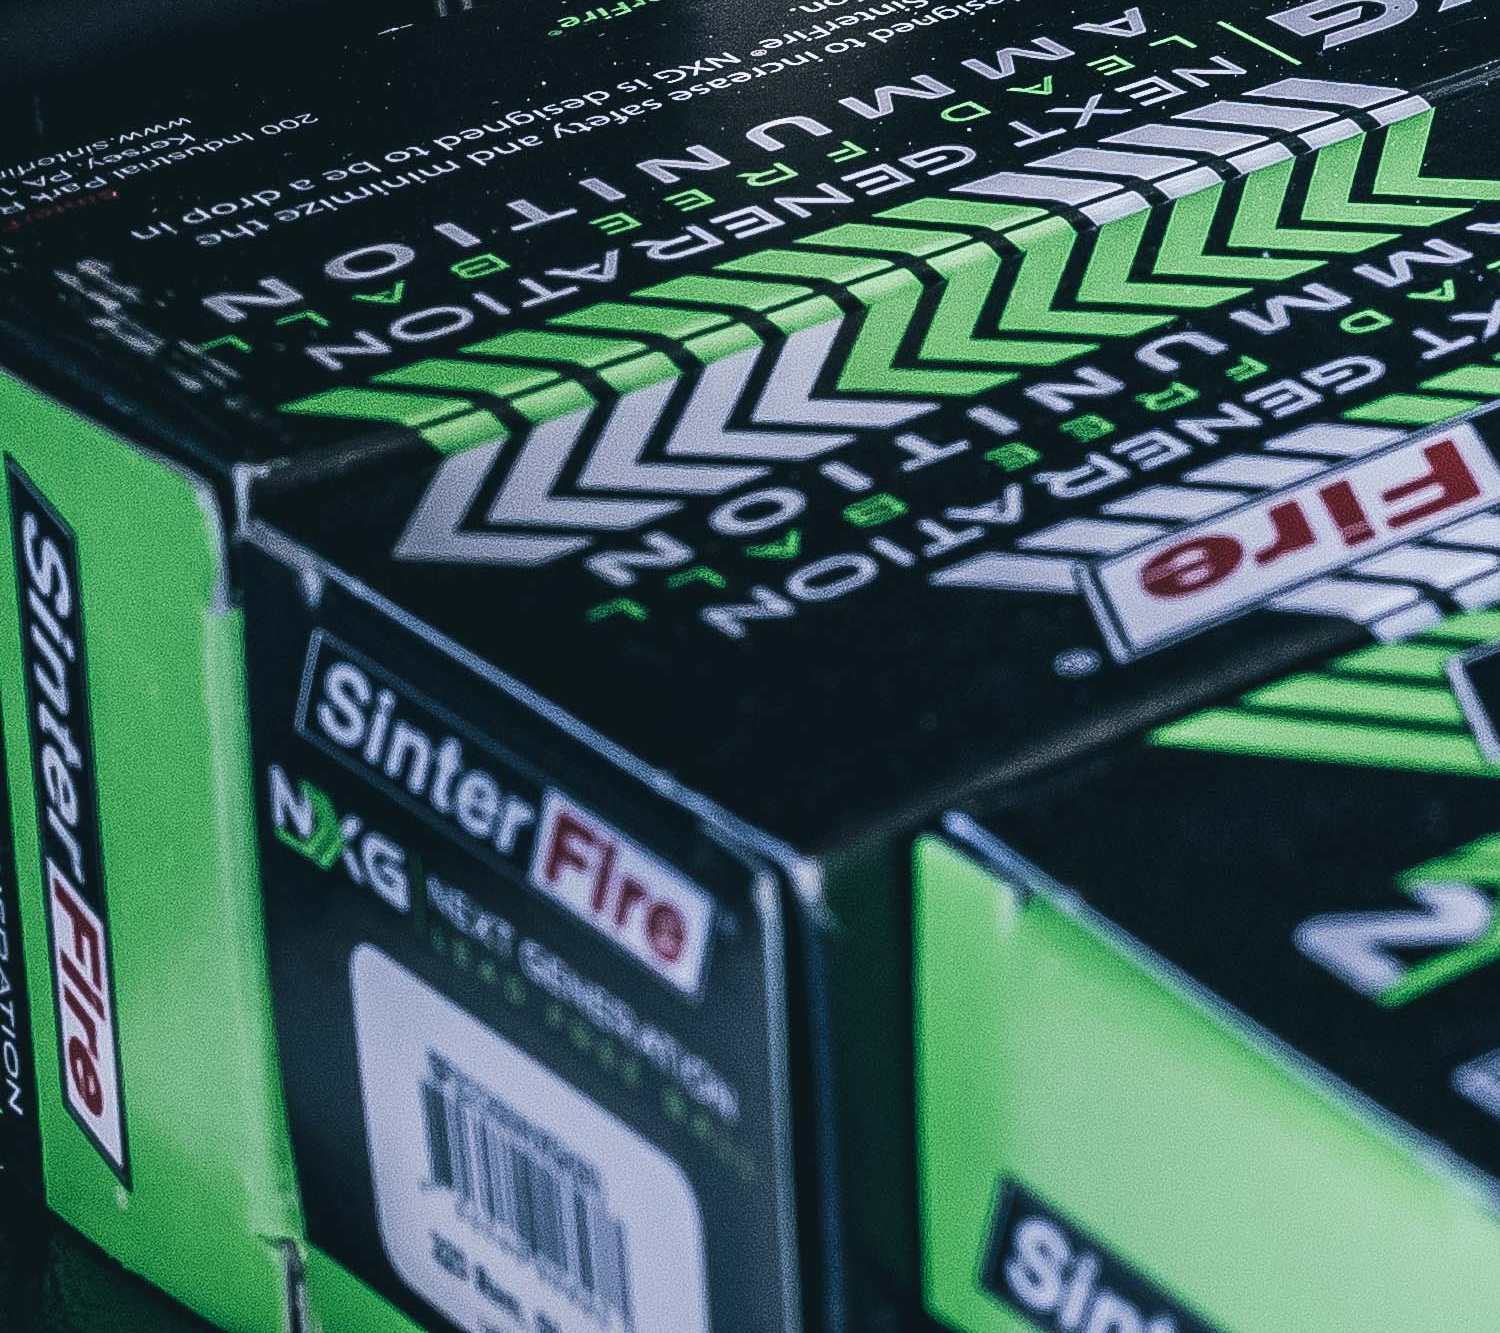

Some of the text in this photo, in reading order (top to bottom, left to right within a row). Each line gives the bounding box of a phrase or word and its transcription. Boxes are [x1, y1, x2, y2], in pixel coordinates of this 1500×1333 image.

[653, 50, 741, 85] NXG
[825, 38, 867, 57] to
[616, 77, 652, 93] is
[668, 46, 824, 102] increase
[433, 90, 611, 153] designed
[553, 96, 662, 139] safety
[30, 113, 319, 204] 200 Industrial Park
[202, 6, 1147, 322] AMMUNITION
[323, 161, 381, 182] be
[385, 145, 430, 164] to
[467, 133, 544, 168] and
[23, 170, 73, 190] PA
[200, 33, 1197, 354] LEAD FREE BALL
[274, 159, 462, 222] minimize
[289, 177, 314, 191] a
[130, 220, 178, 241] in
[183, 188, 281, 224] drop
[304, 54, 1247, 370] NEXT GENERATION
[194, 218, 270, 246] the
[986, 354, 1270, 471] FREE
[700, 353, 1387, 639] GENERATION
[24, 514, 107, 1118] SinterFire
[269, 764, 411, 915] NXG
[316, 663, 691, 967] SinterFire
